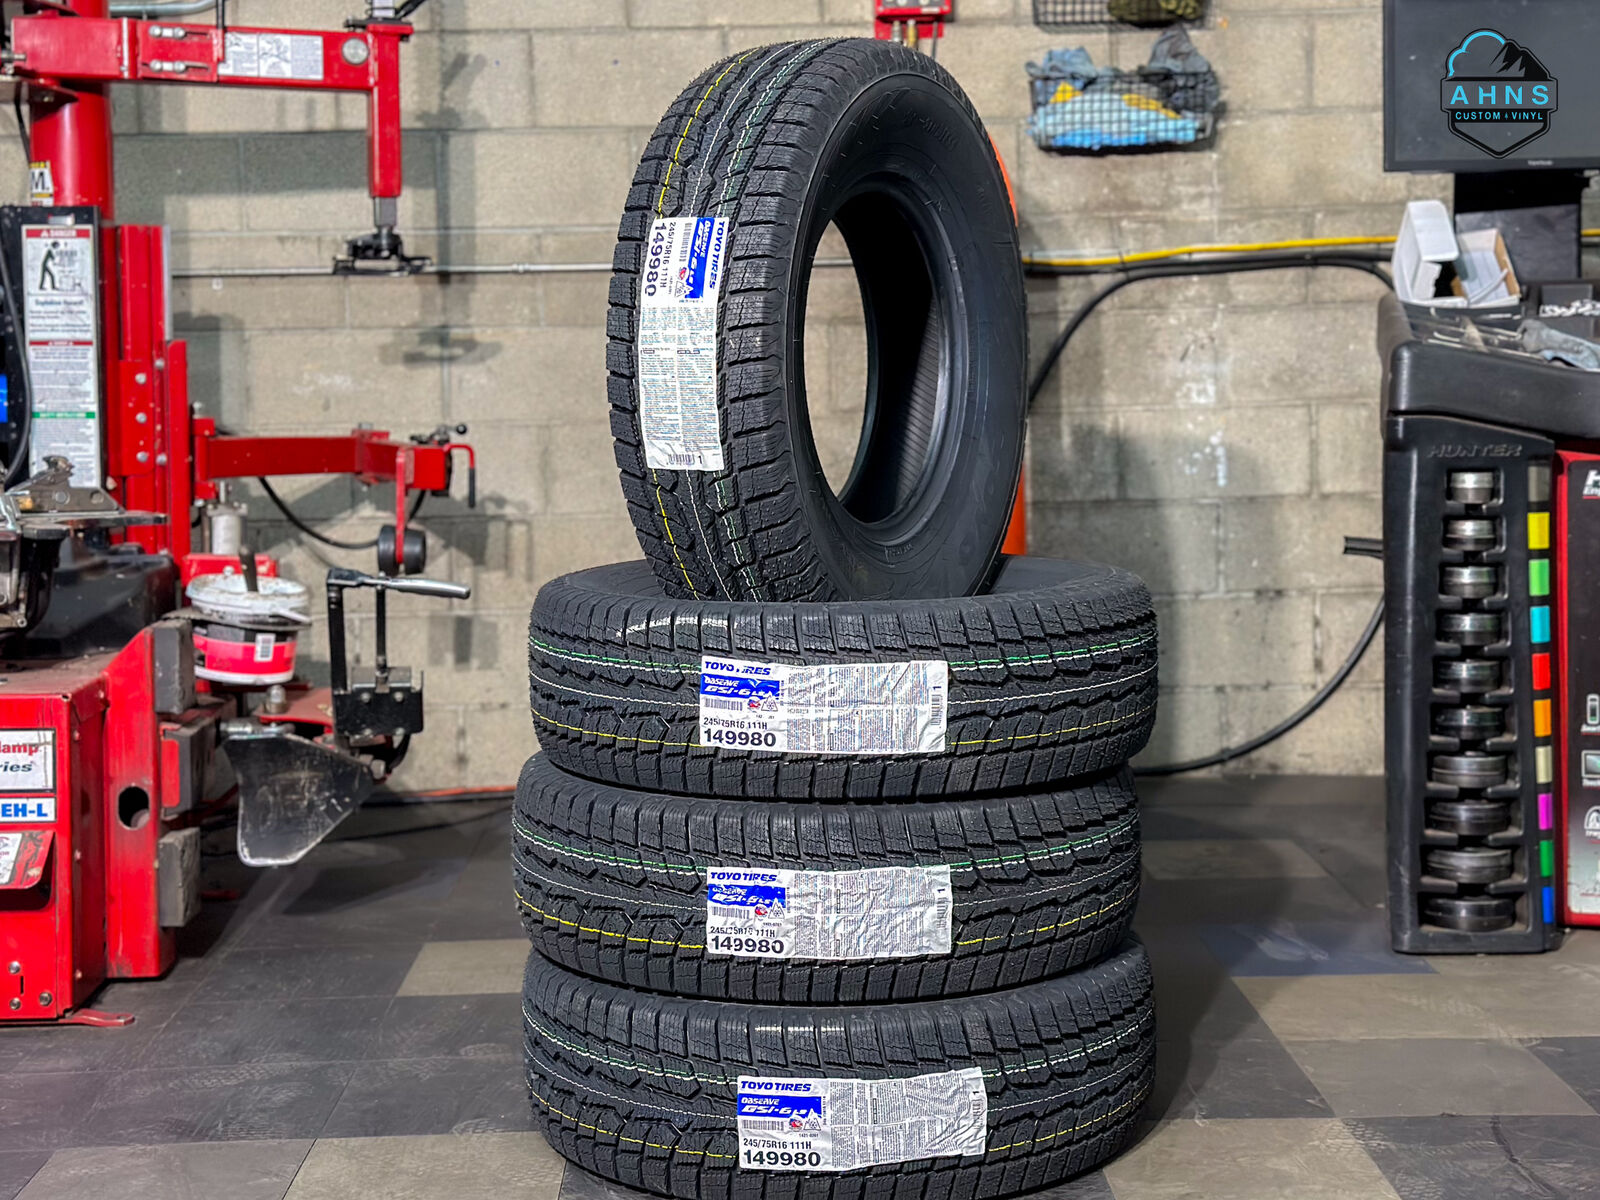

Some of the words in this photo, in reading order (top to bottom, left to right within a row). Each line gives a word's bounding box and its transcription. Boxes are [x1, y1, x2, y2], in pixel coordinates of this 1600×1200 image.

[662, 221, 677, 265] 245/75R16
[714, 221, 725, 252] TOYO
[660, 267, 668, 288] 111H
[1428, 444, 1523, 458] HUNTER
[705, 661, 735, 672] TOYO
[748, 721, 768, 730] 111H
[704, 728, 777, 747] 149980
[0, 741, 39, 756] amp
[1, 803, 48, 818] EH-L
[711, 872, 742, 881] TOYO
[743, 873, 778, 882] TIRES
[711, 935, 785, 954] 149980
[741, 1081, 773, 1090] TOYO
[774, 1082, 812, 1092] TIRES
[743, 1138, 788, 1149] 245/75R16
[791, 1141, 812, 1150] 111H
[744, 1149, 821, 1167] 149980
